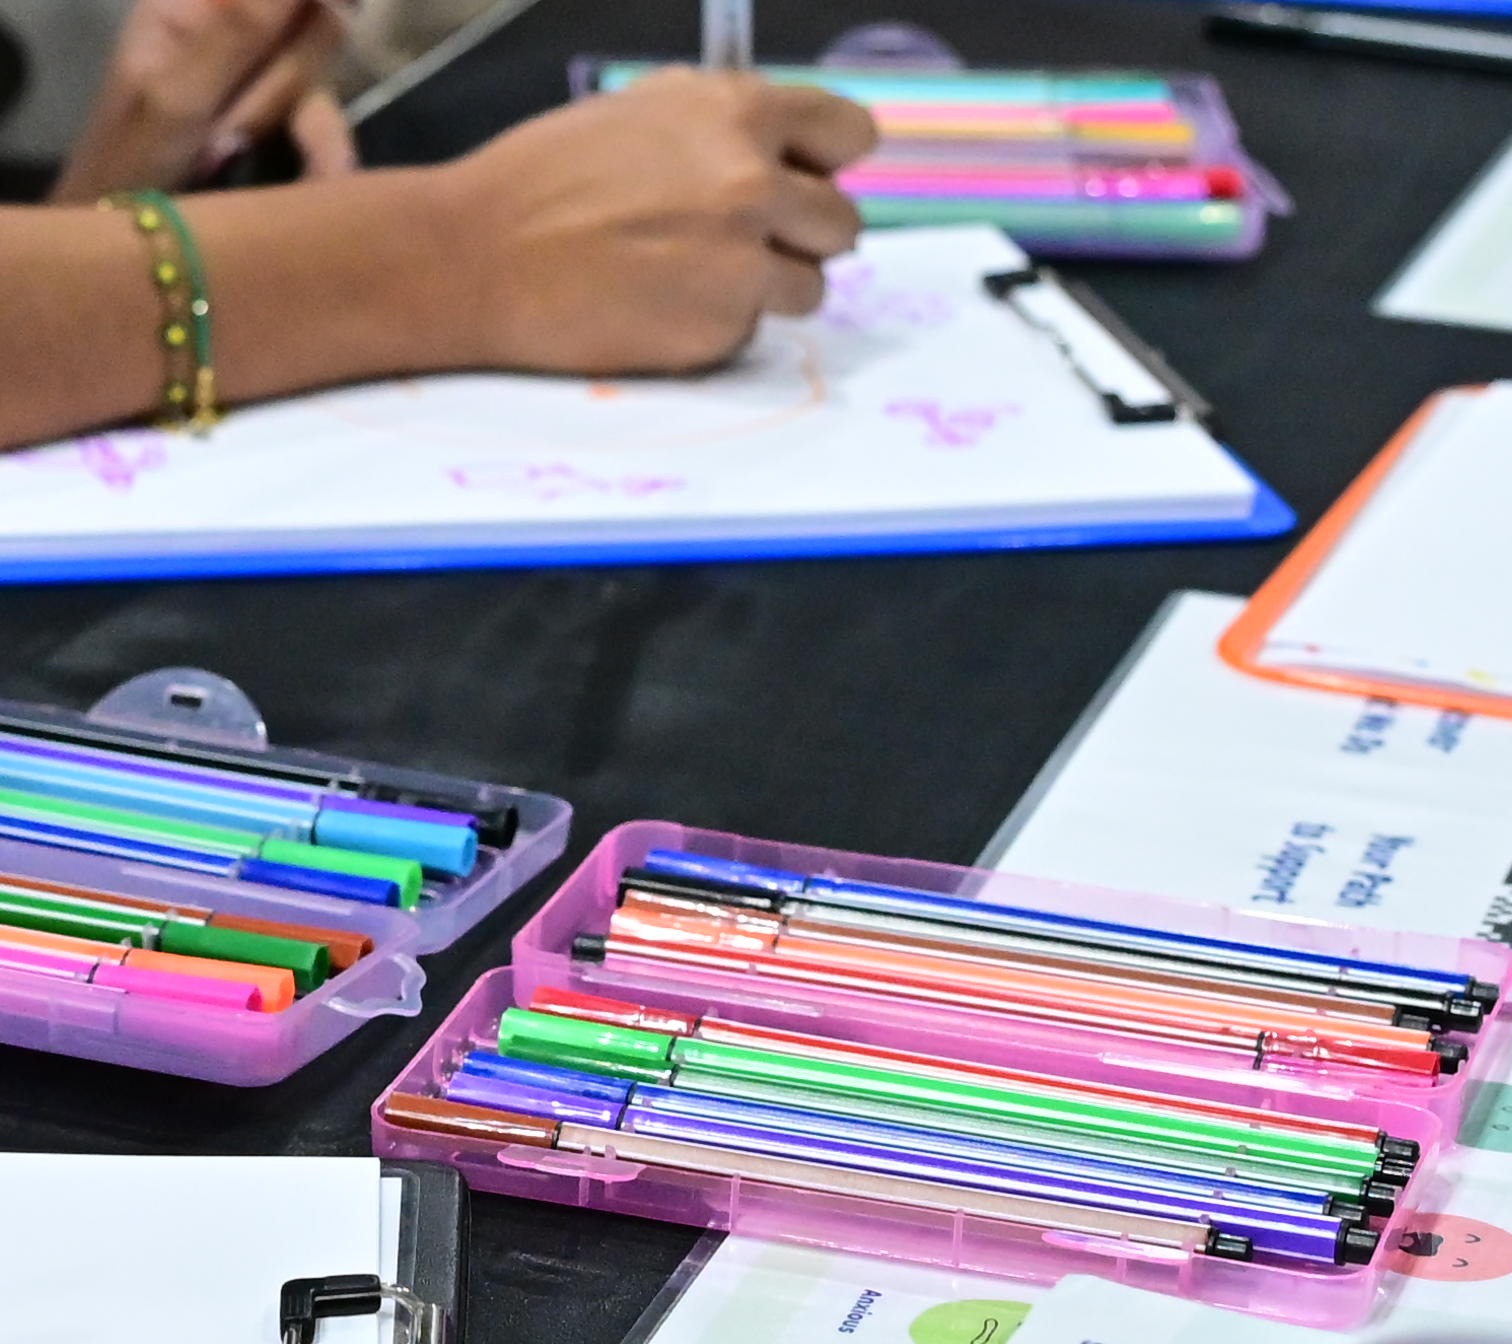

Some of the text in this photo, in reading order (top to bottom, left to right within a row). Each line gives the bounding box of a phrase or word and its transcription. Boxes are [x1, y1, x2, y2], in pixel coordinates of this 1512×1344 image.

[1249, 821, 1336, 904] to Support
[1360, 833, 1417, 869] Your
[837, 1288, 883, 1334] Anxious
